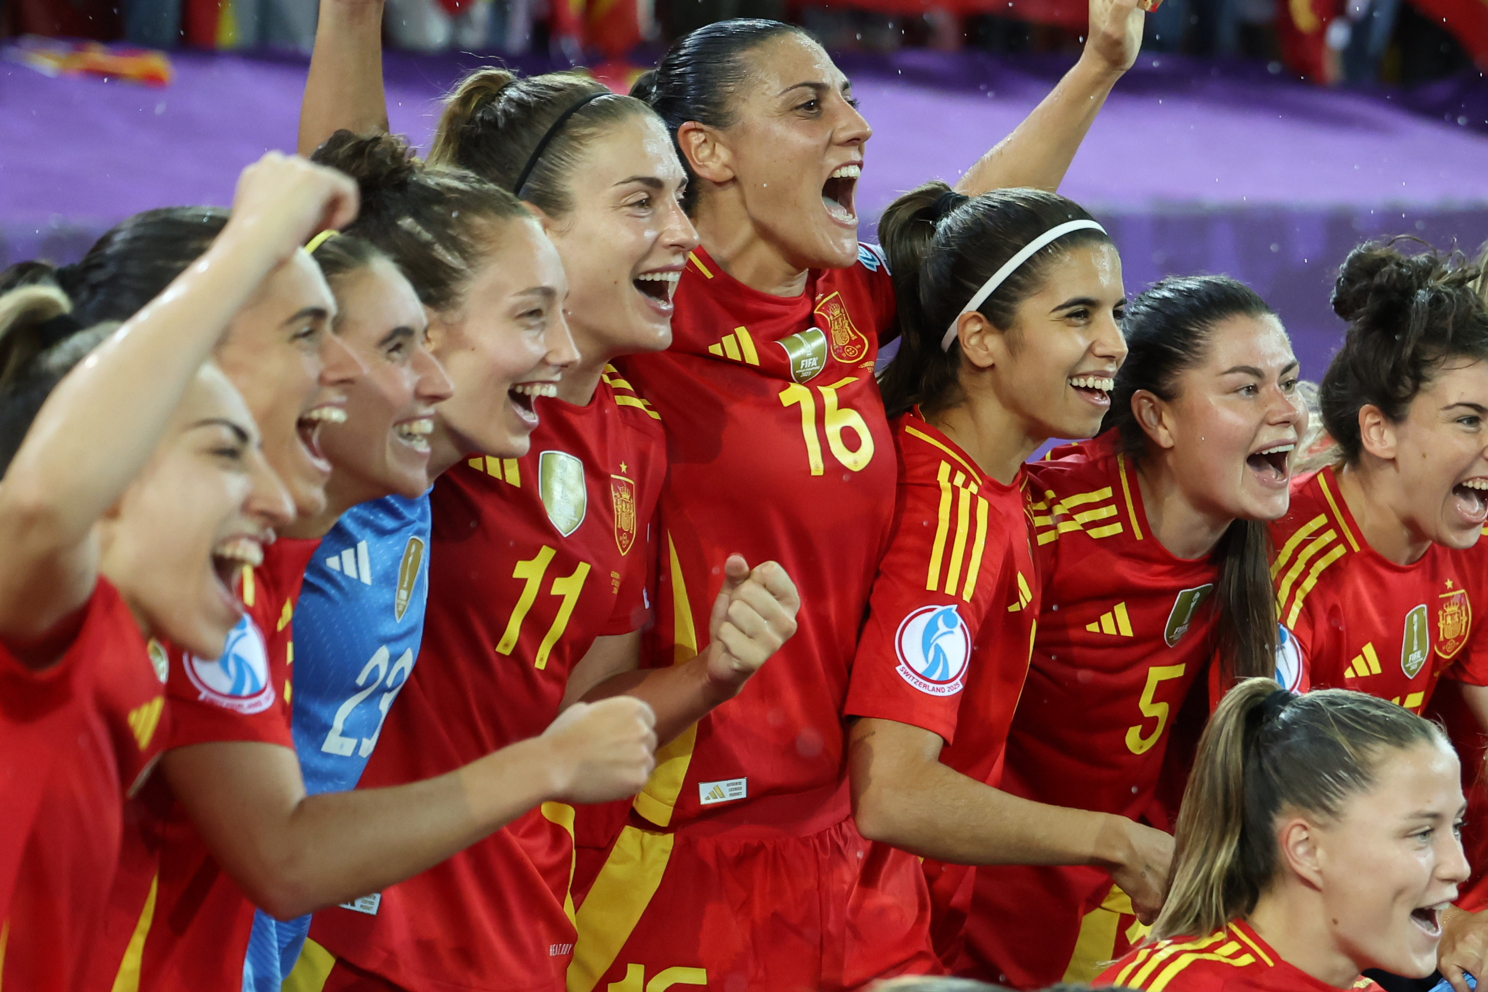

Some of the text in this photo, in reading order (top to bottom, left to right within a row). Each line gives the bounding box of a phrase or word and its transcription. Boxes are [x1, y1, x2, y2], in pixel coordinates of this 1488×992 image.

[800, 357, 818, 369] FIFA
[778, 376, 875, 476] 16
[495, 545, 592, 670] 11
[900, 666, 961, 694] SWITZERLAND 2025
[1125, 663, 1186, 755] 5
